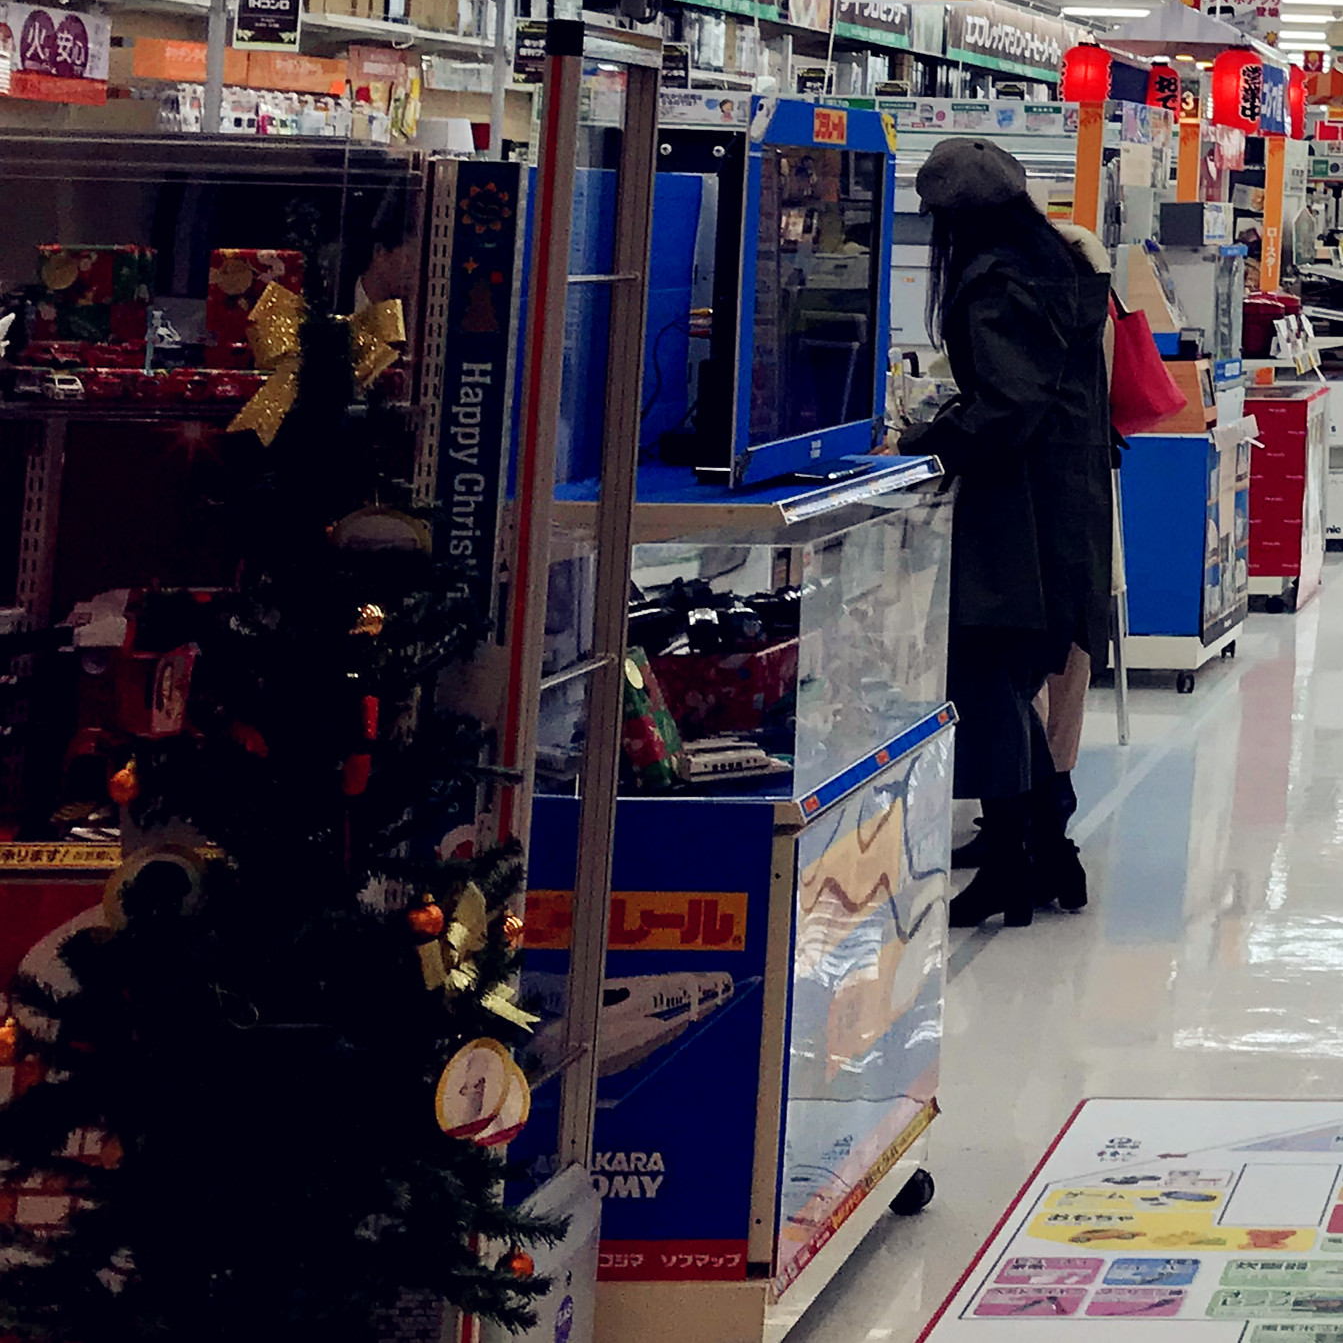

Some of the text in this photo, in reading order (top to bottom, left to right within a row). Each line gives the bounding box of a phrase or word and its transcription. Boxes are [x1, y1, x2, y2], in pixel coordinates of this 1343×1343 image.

[1155, 75, 1178, 111] おで
[1267, 227, 1277, 277] ロースター
[449, 361, 492, 465] Happy
[599, 1253, 741, 1268] コジマ ソフマップ
